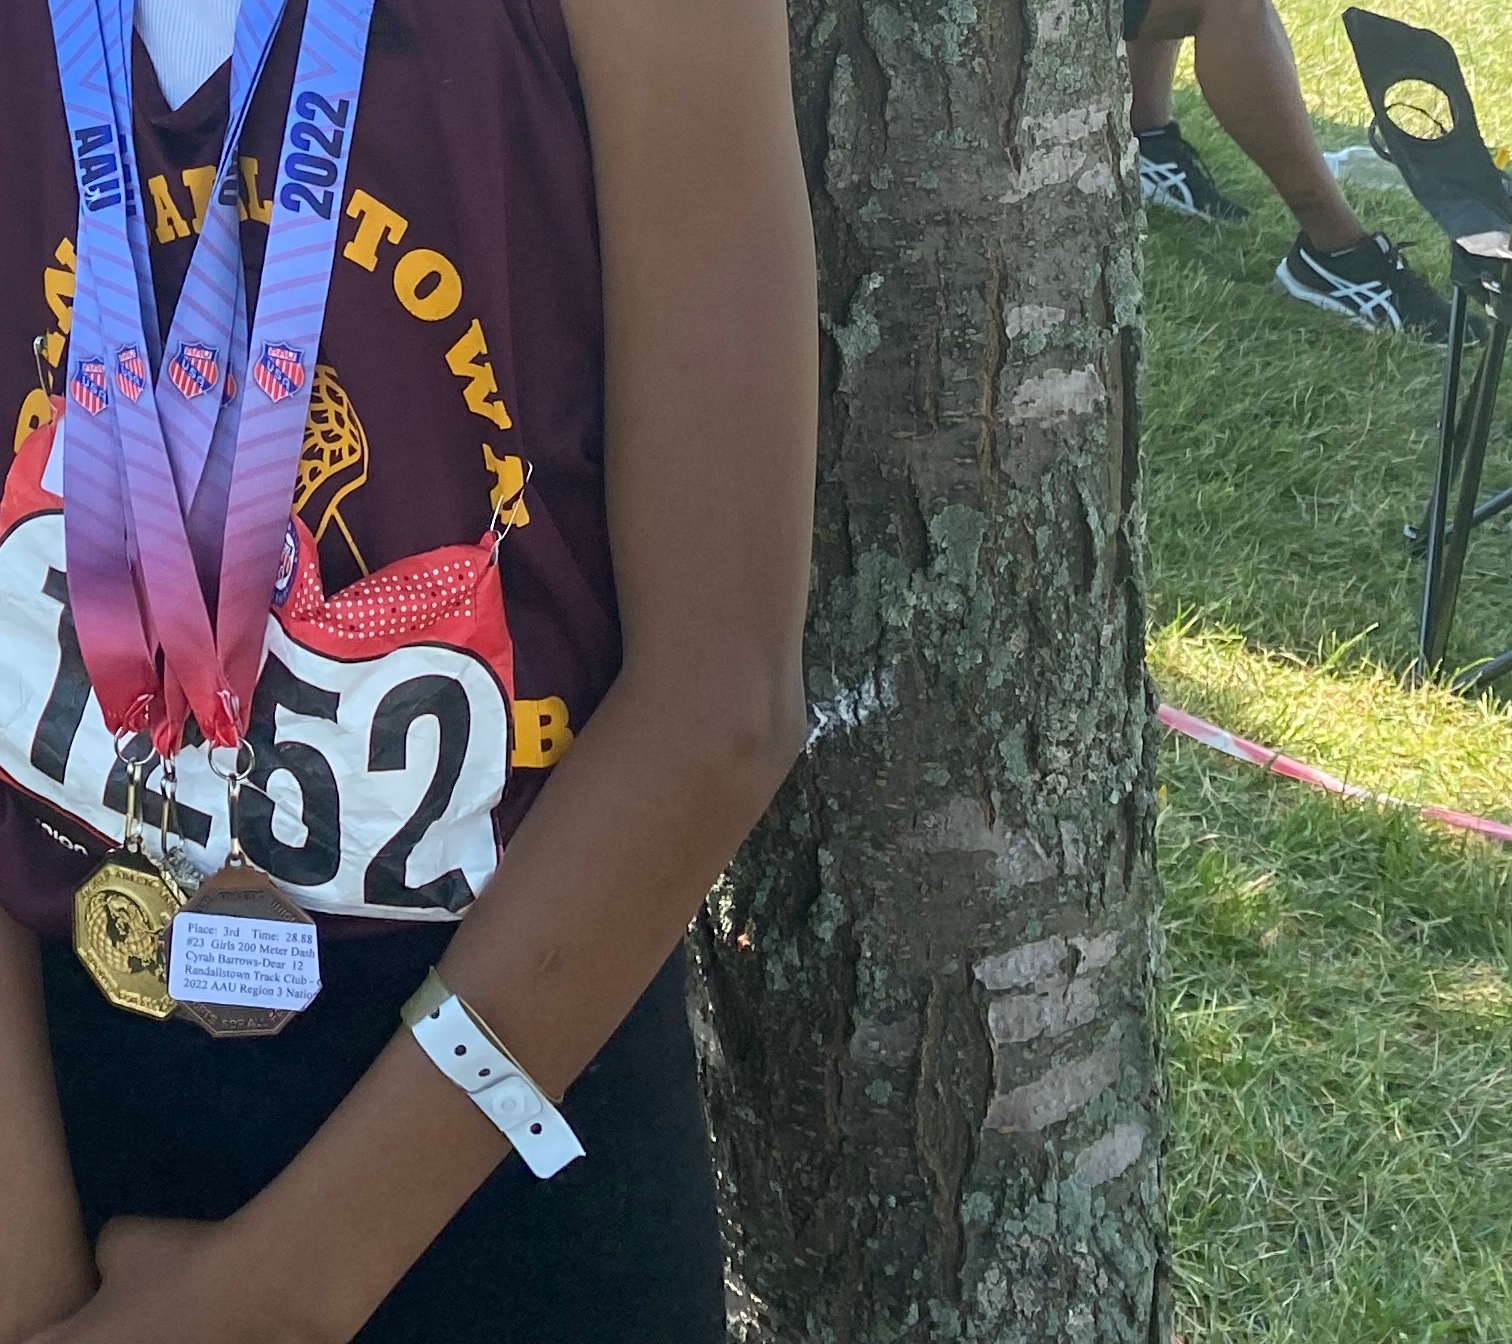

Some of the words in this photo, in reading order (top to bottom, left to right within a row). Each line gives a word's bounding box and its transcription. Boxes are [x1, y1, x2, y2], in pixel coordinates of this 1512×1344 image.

[279, 91, 350, 220] 2022
[74, 124, 121, 212] AAU
[188, 922, 217, 936] Place:
[223, 926, 240, 938] 3rd
[251, 928, 280, 941] Time:
[285, 932, 313, 944] 28.88
[187, 936, 205, 948] #23
[210, 938, 236, 951] Girls
[237, 941, 257, 953] 200
[259, 943, 288, 956] Meter
[290, 946, 317, 959] Dash
[185, 950, 215, 964] Cyrah
[217, 952, 286, 970] Barrows-Dear
[292, 960, 304, 971] 12
[184, 963, 251, 981] Randallstown
[252, 970, 281, 983] Track
[283, 973, 308, 986] Club
[183, 977, 208, 990] 2022
[210, 979, 237, 993] AAU
[239, 983, 275, 997] Region
[276, 986, 284, 997] 3
